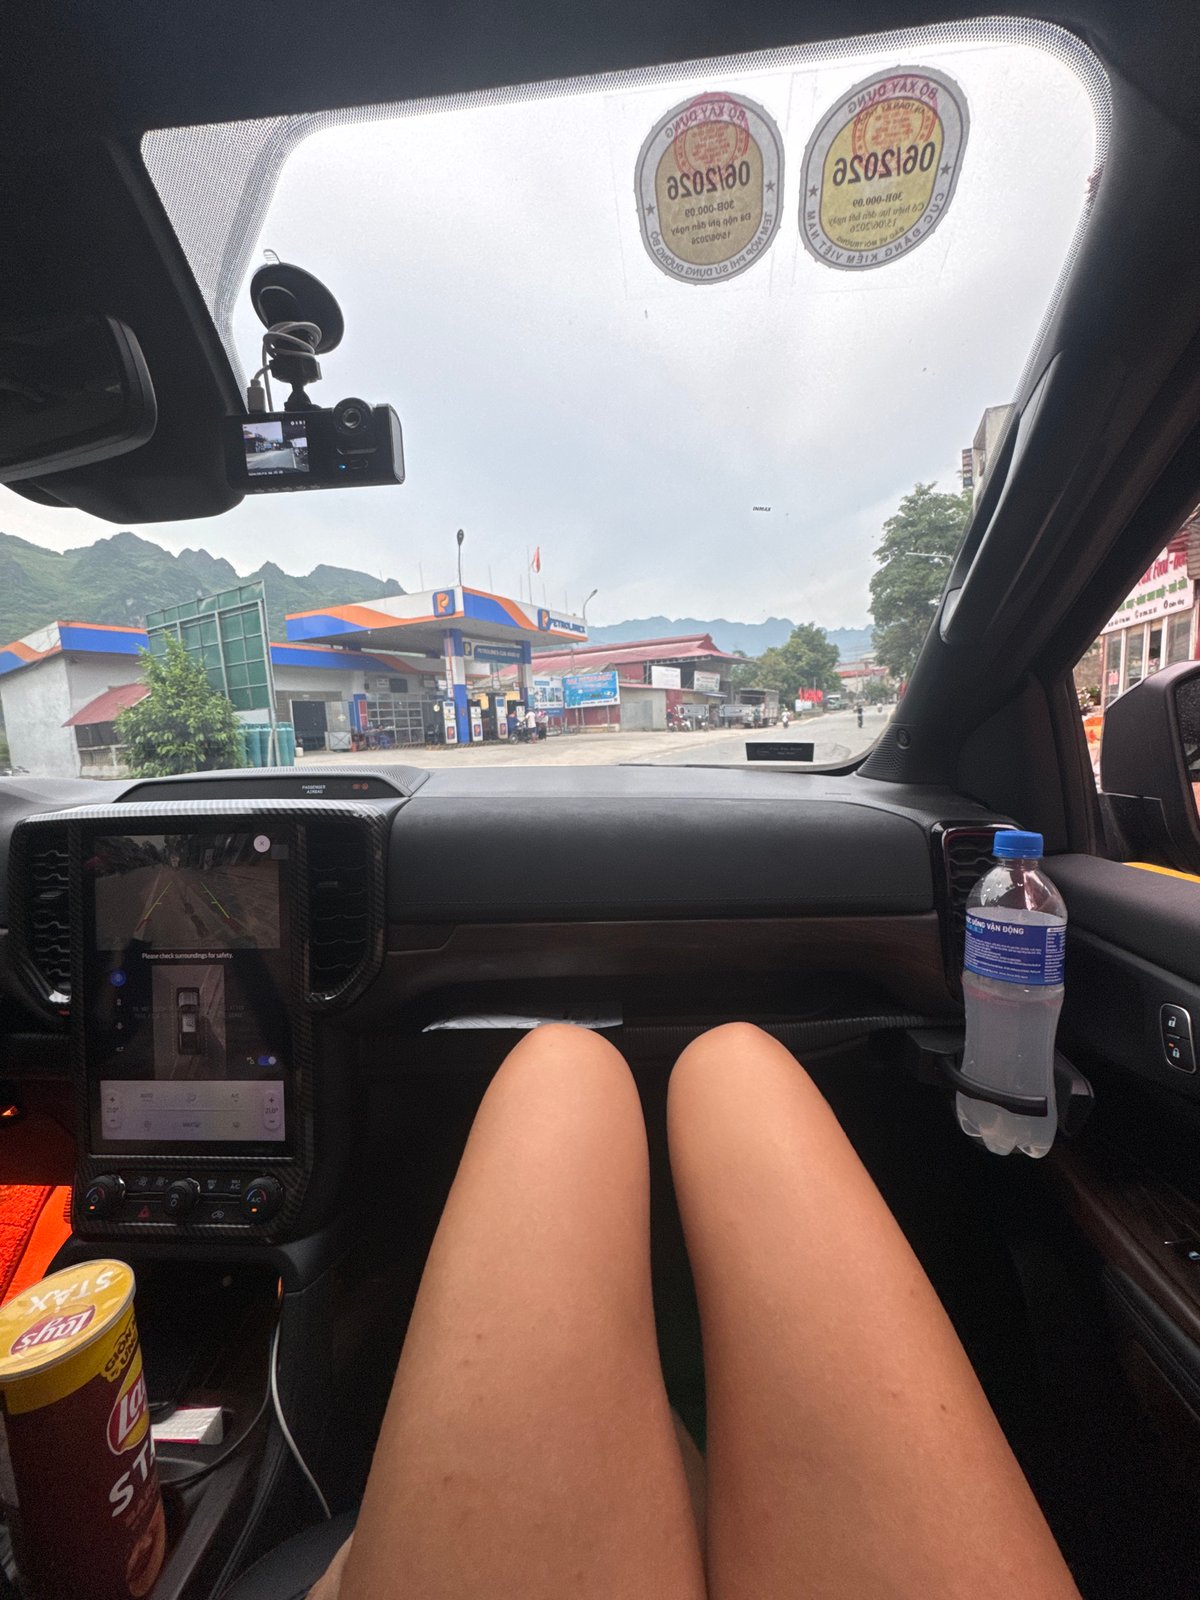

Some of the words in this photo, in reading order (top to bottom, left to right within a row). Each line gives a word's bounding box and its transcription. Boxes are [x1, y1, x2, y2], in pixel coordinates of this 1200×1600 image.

[987, 922, 1001, 933] VẬN
[1002, 925, 1025, 935] ĐỘNG
[142, 952, 159, 960] Please
[159, 952, 174, 960] check
[175, 952, 208, 961] surroundings
[25, 1271, 113, 1314] STAX
